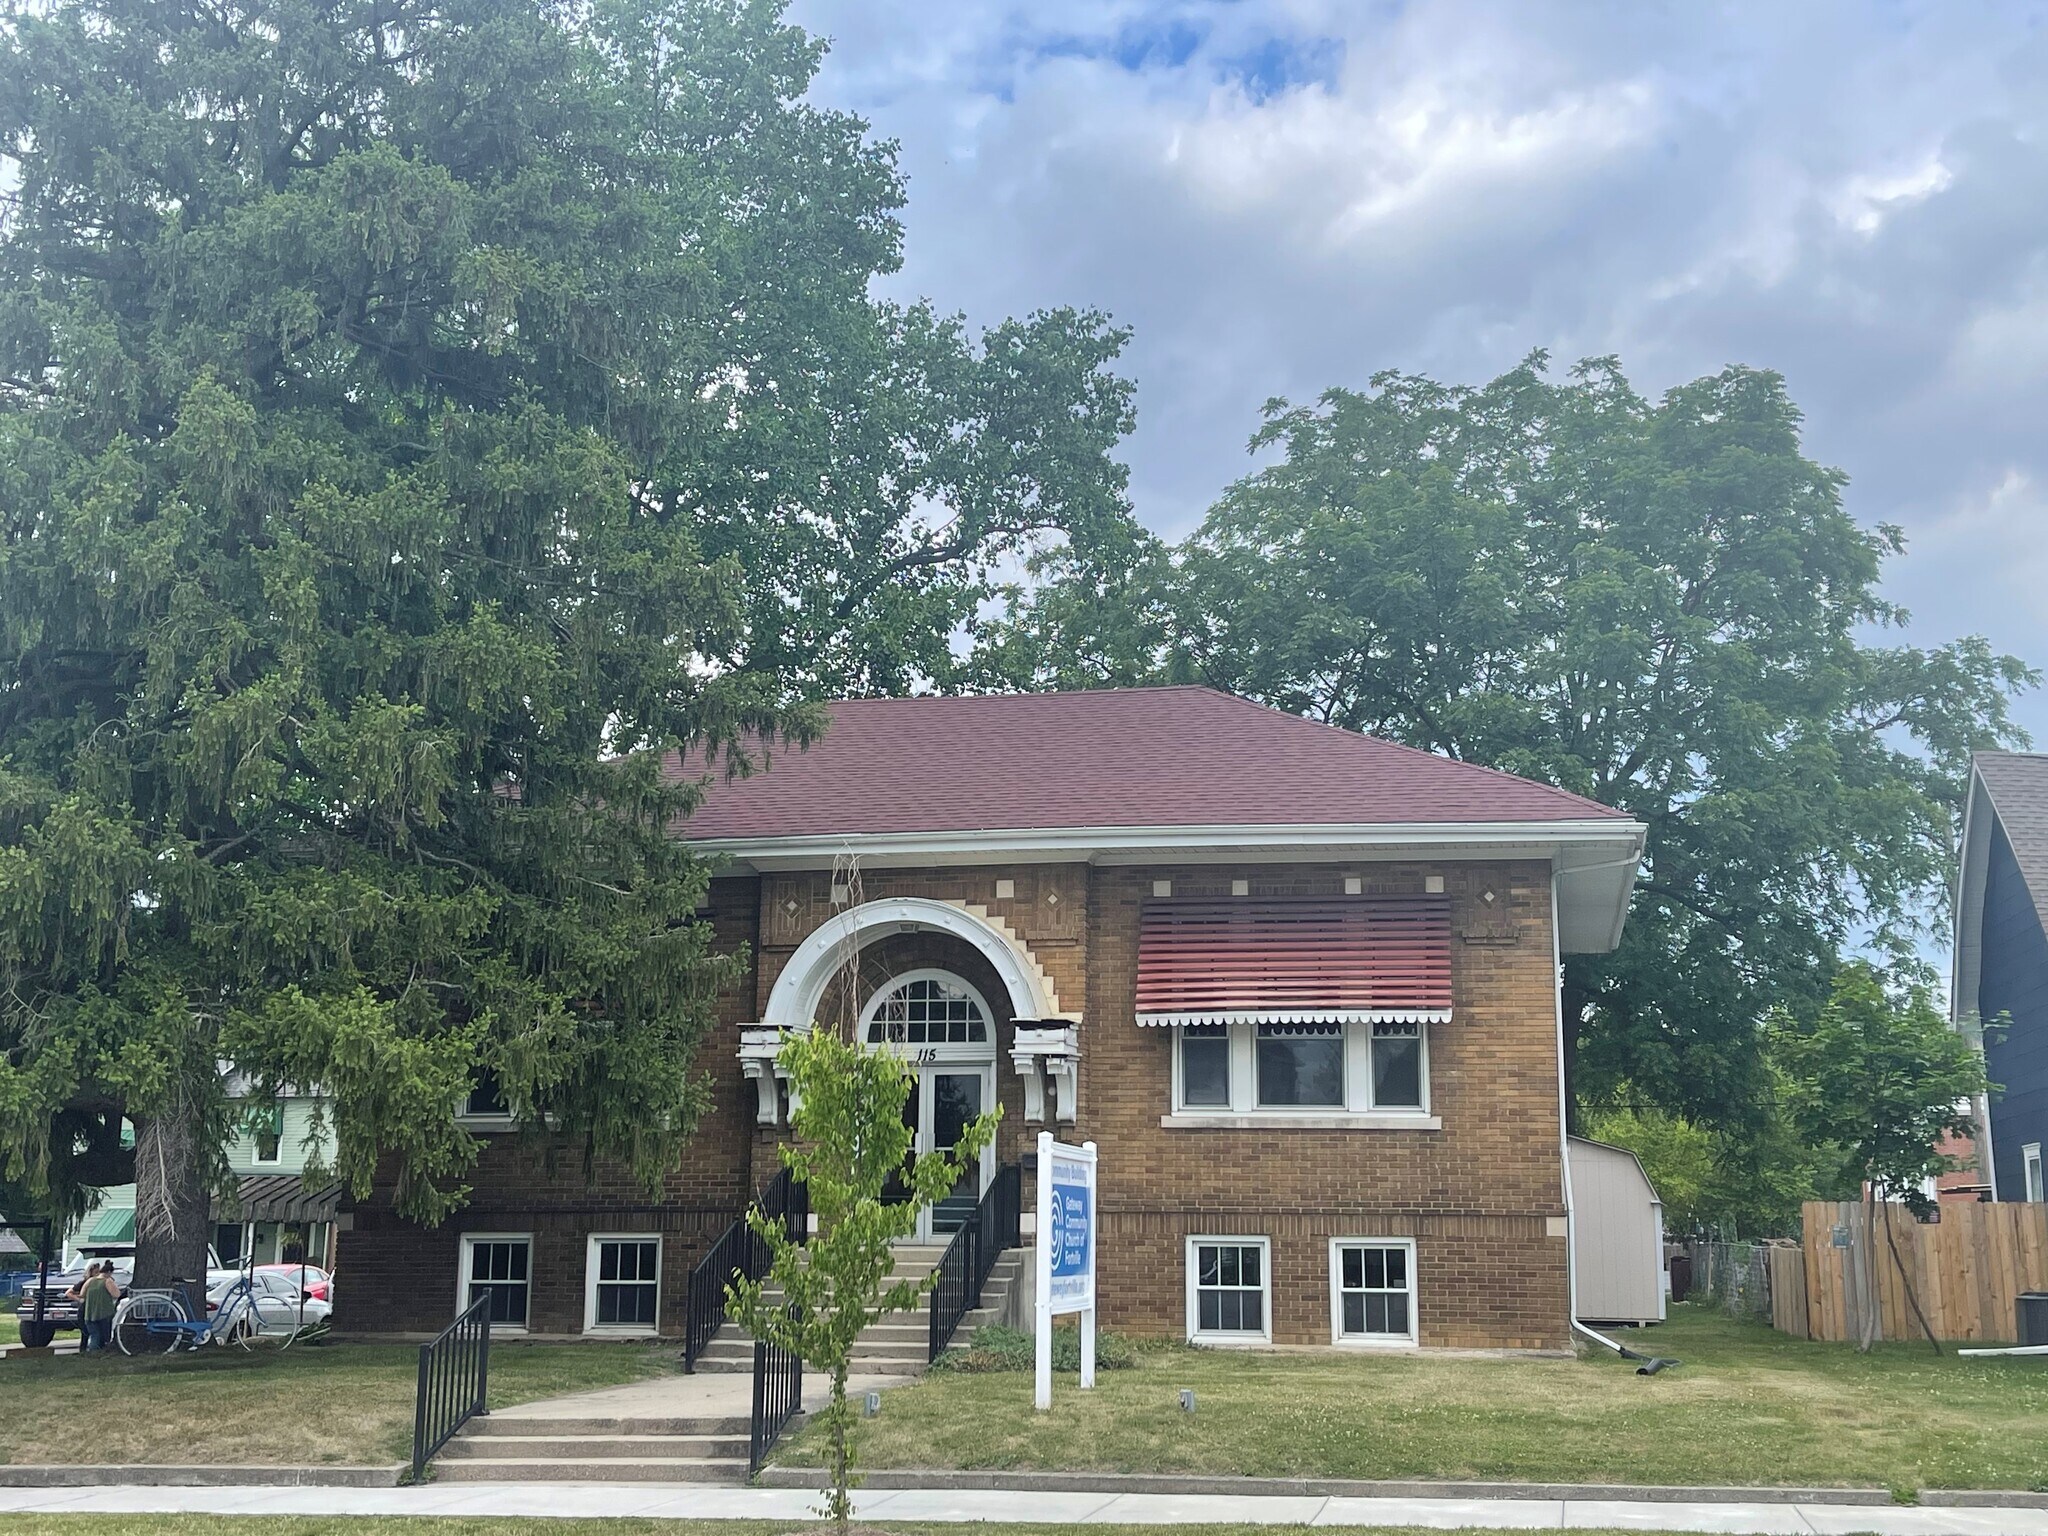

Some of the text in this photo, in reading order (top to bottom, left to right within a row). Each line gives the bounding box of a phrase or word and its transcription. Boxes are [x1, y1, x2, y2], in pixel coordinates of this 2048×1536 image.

[917, 1048, 937, 1062] 115
[1066, 1196, 1083, 1214] Gateway
[1065, 1214, 1088, 1233] Community
[1065, 1232, 1079, 1247] Church
